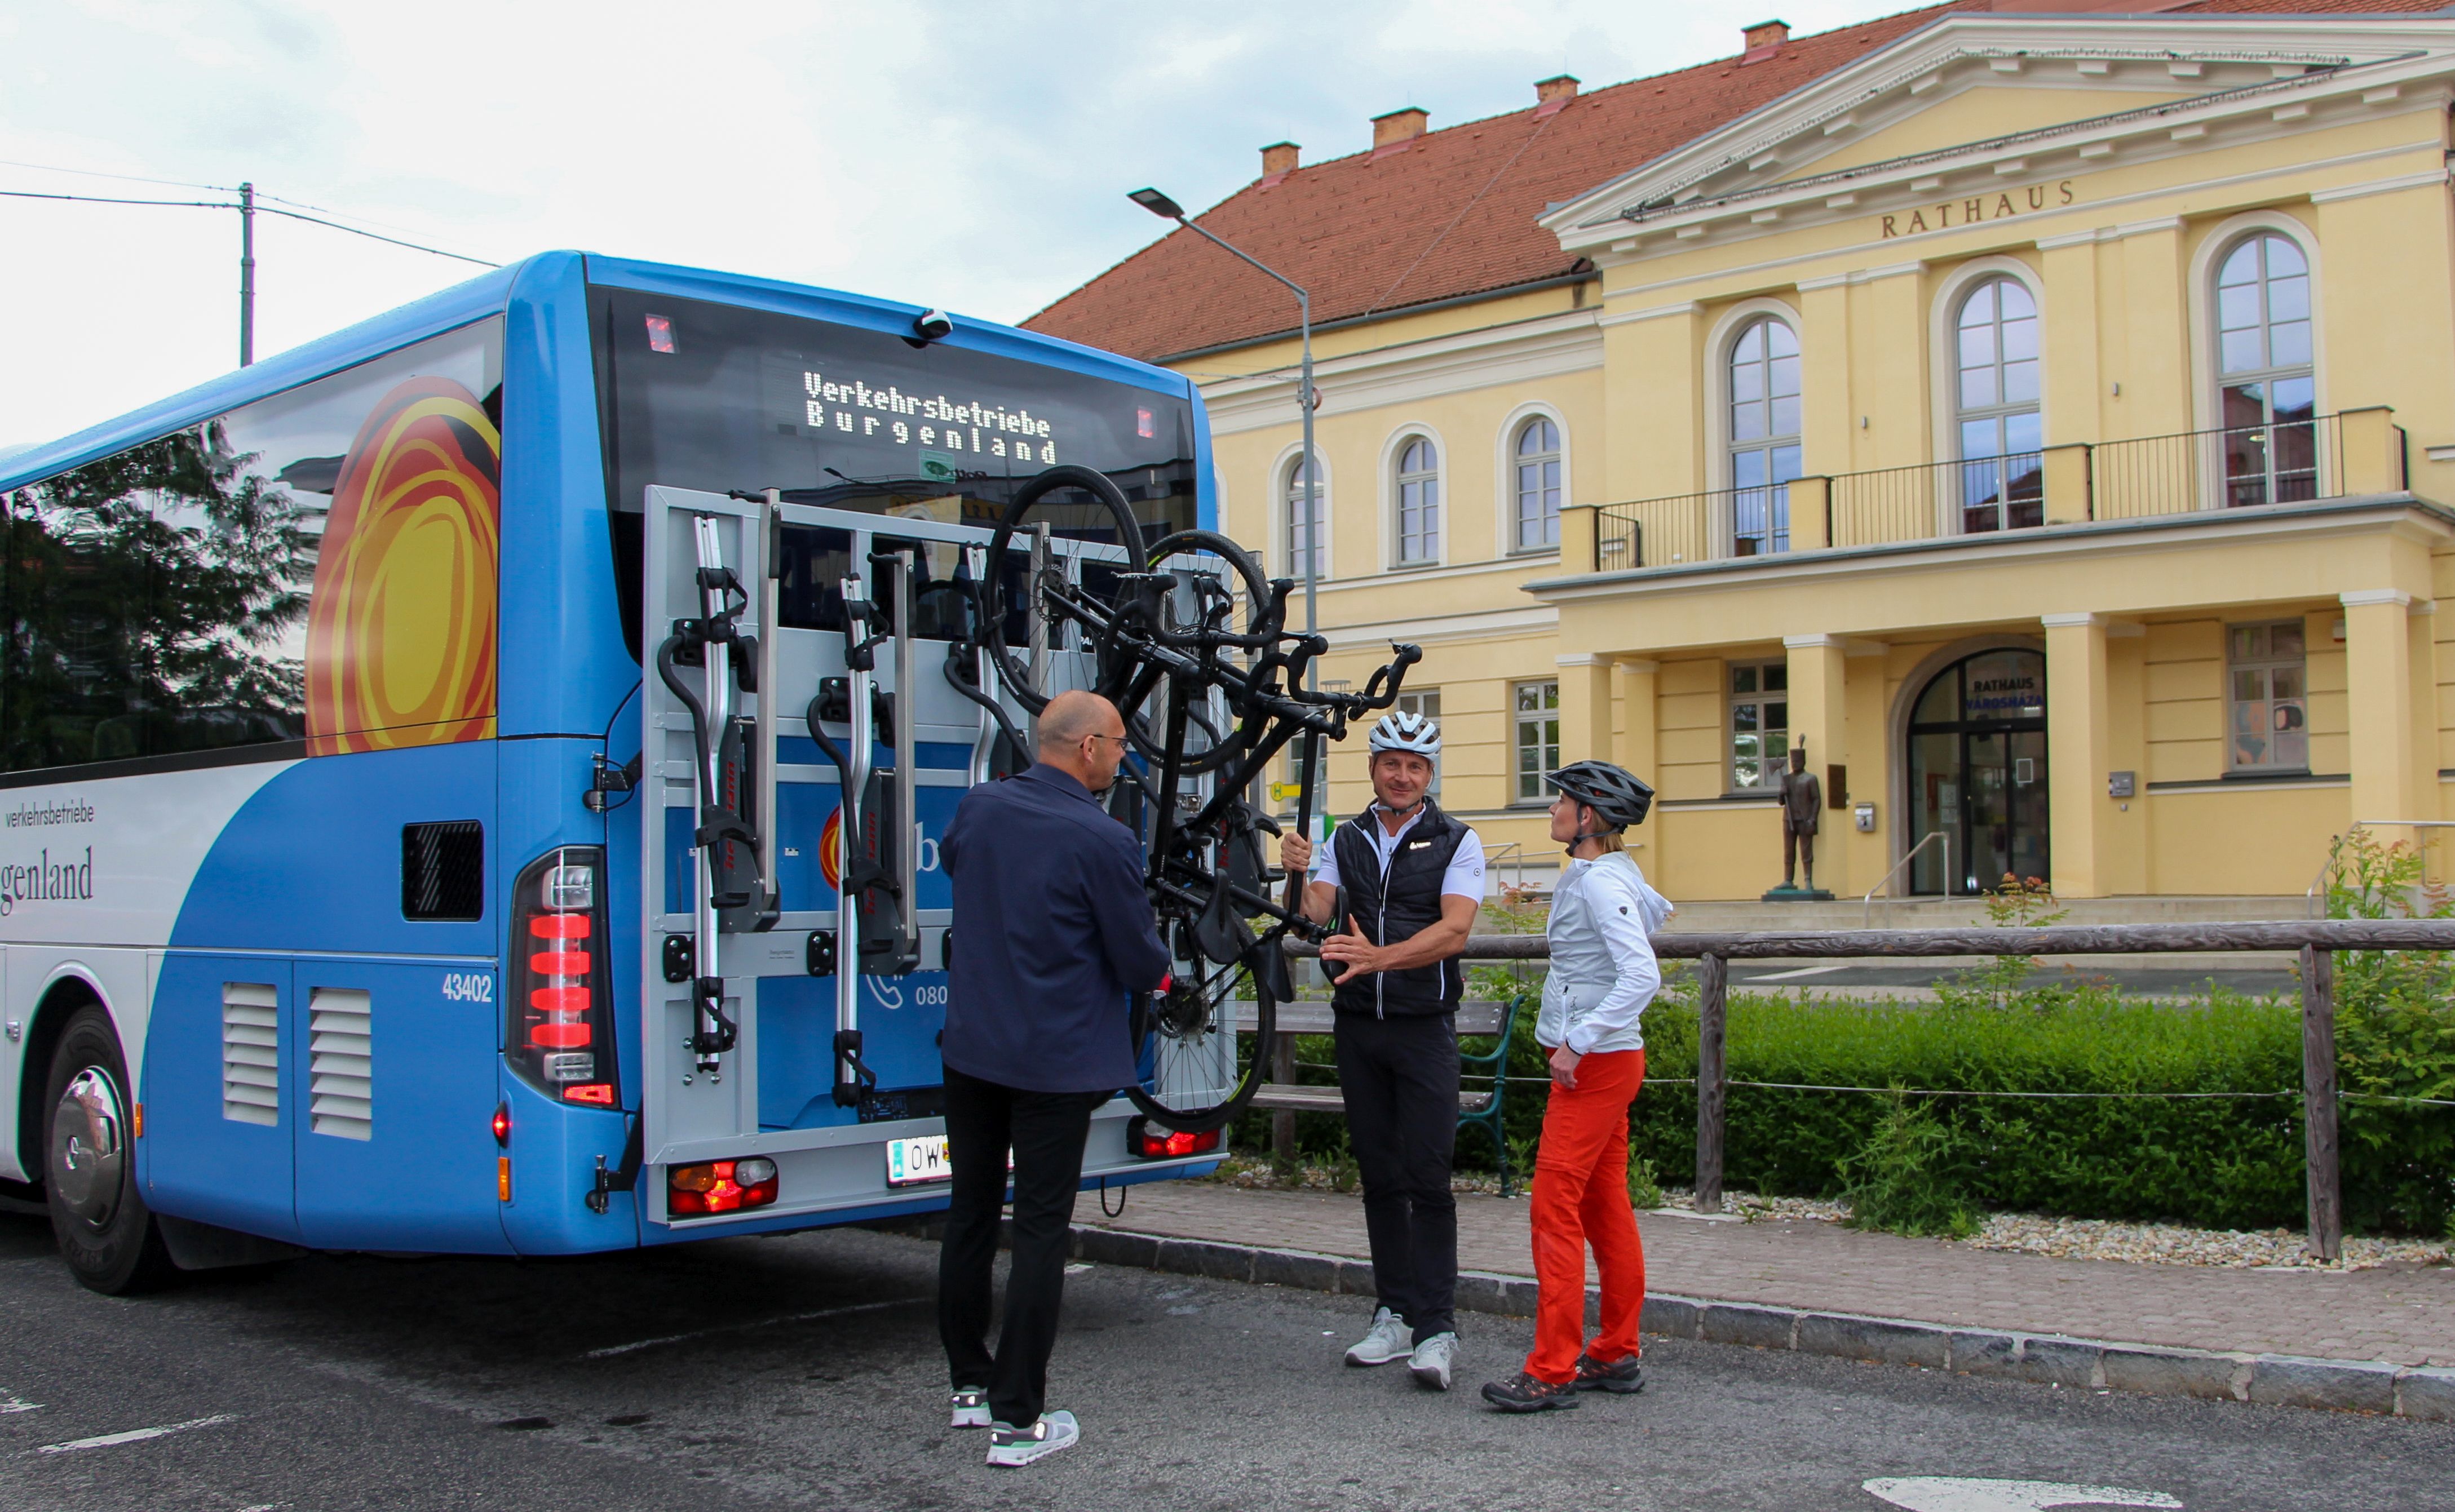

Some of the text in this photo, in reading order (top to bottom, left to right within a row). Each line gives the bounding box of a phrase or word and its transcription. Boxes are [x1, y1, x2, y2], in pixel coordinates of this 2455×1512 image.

[1882, 180, 2073, 238] RATHAUS
[804, 371, 1051, 438] Verkehrsbetriebe
[806, 400, 1057, 465] Burgenland
[1973, 676, 2034, 692] RATHAUS
[1966, 692, 2043, 710] VÁROSHÁZA
[6, 797, 95, 828] verkehrsbetriebe
[442, 973, 492, 1003] 43402
